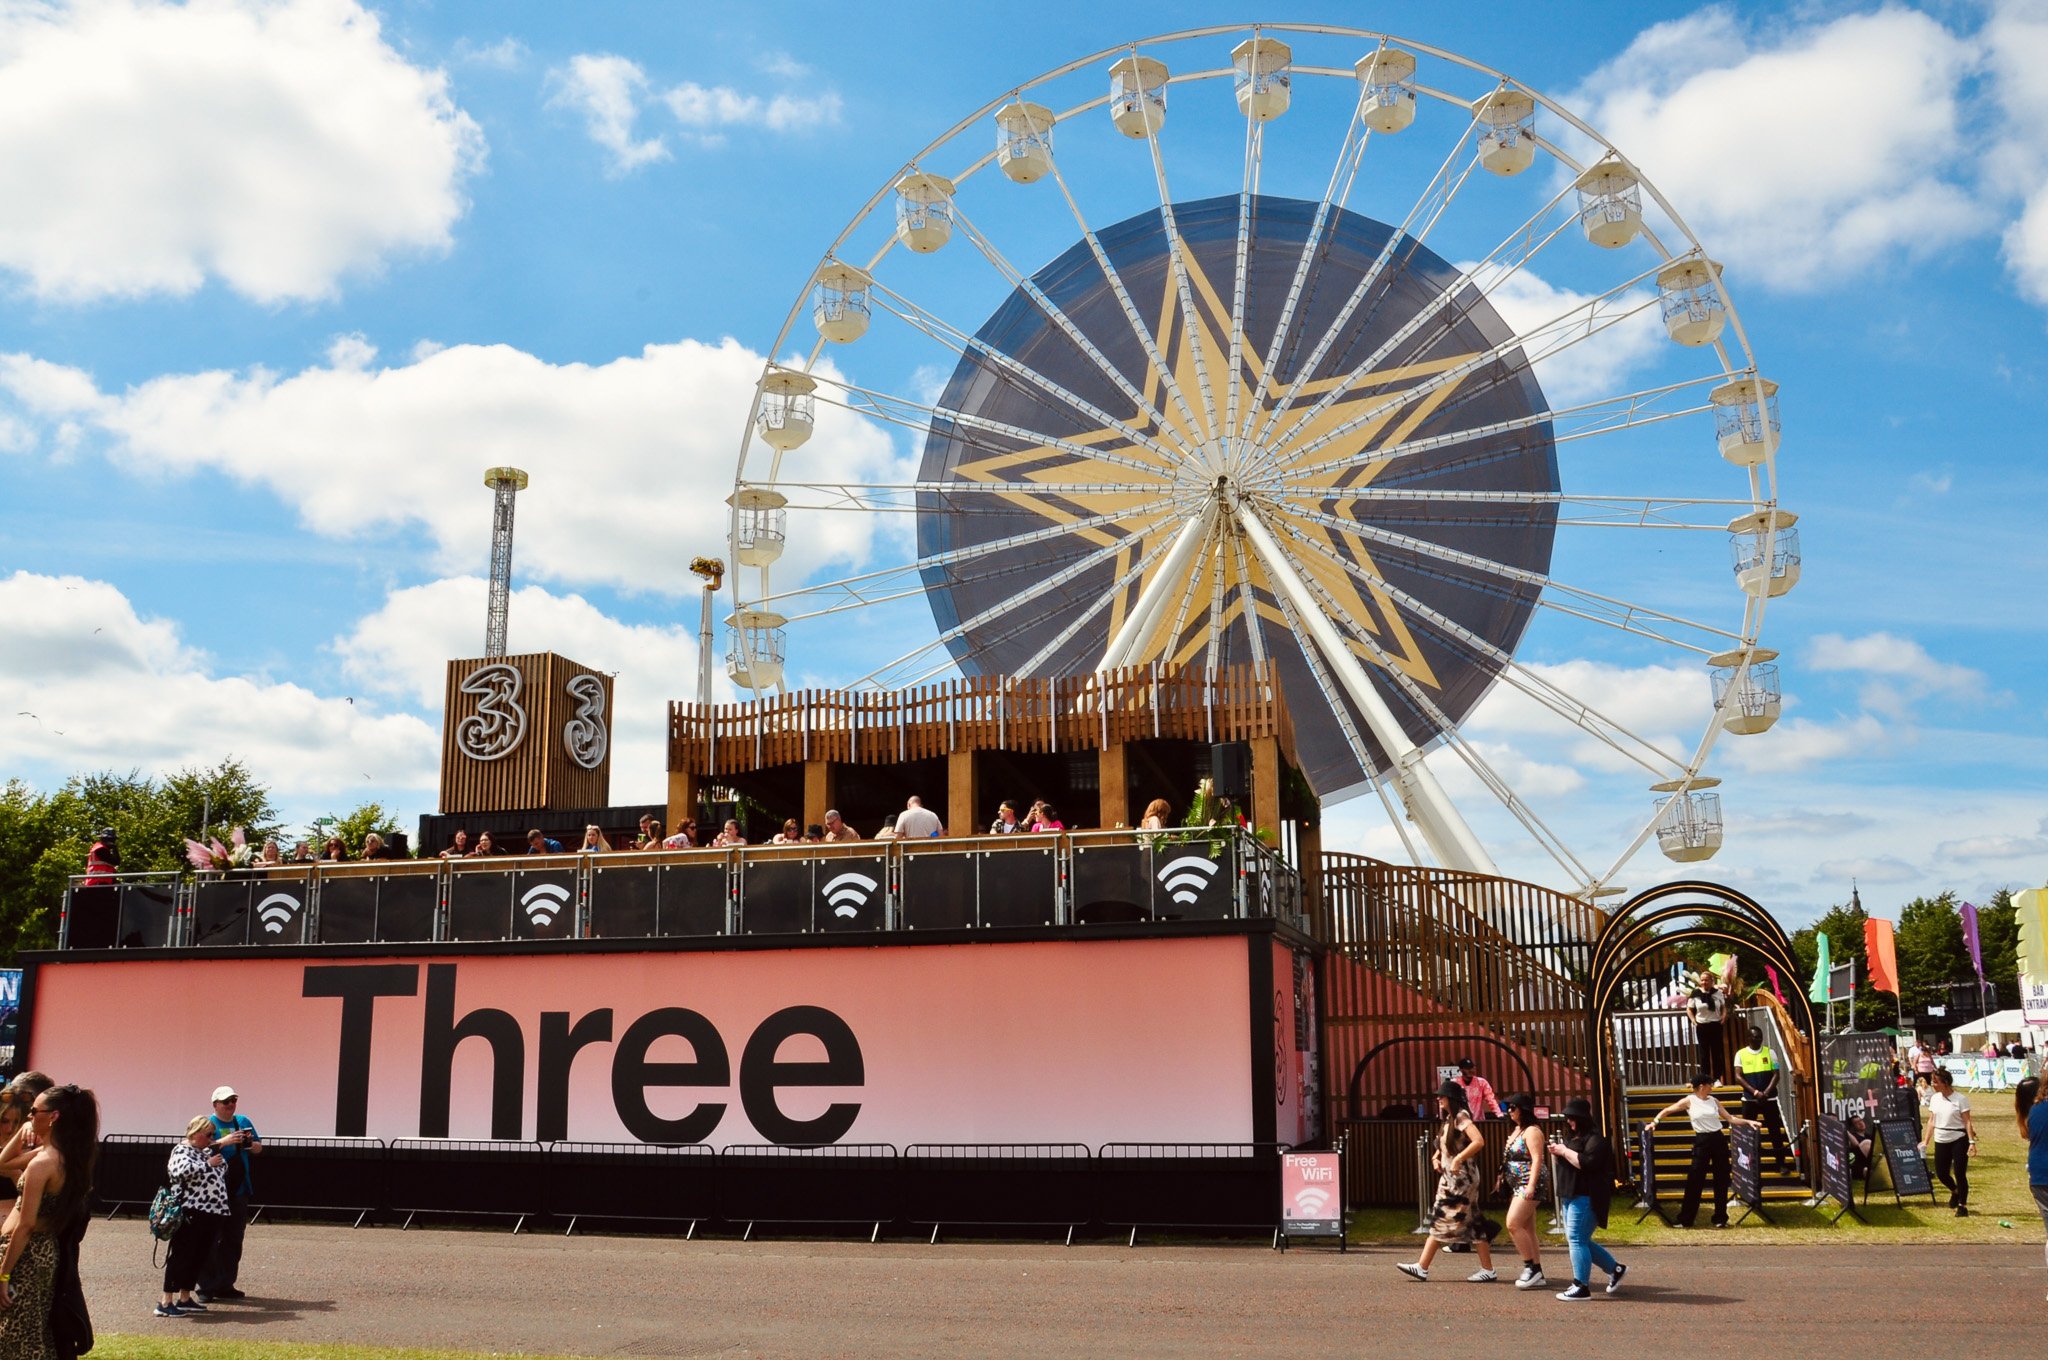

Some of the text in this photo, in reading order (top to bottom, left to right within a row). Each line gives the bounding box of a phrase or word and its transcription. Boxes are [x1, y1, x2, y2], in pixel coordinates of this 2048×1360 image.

[457, 664, 527, 760] 3
[2032, 985, 2044, 997] BAR
[2026, 998, 2048, 1010] ENTRAN
[302, 963, 865, 1149] Three
[1894, 1148, 1914, 1158] Three
[1286, 1154, 1317, 1167] Free
[1301, 1167, 1332, 1180] WiFi
